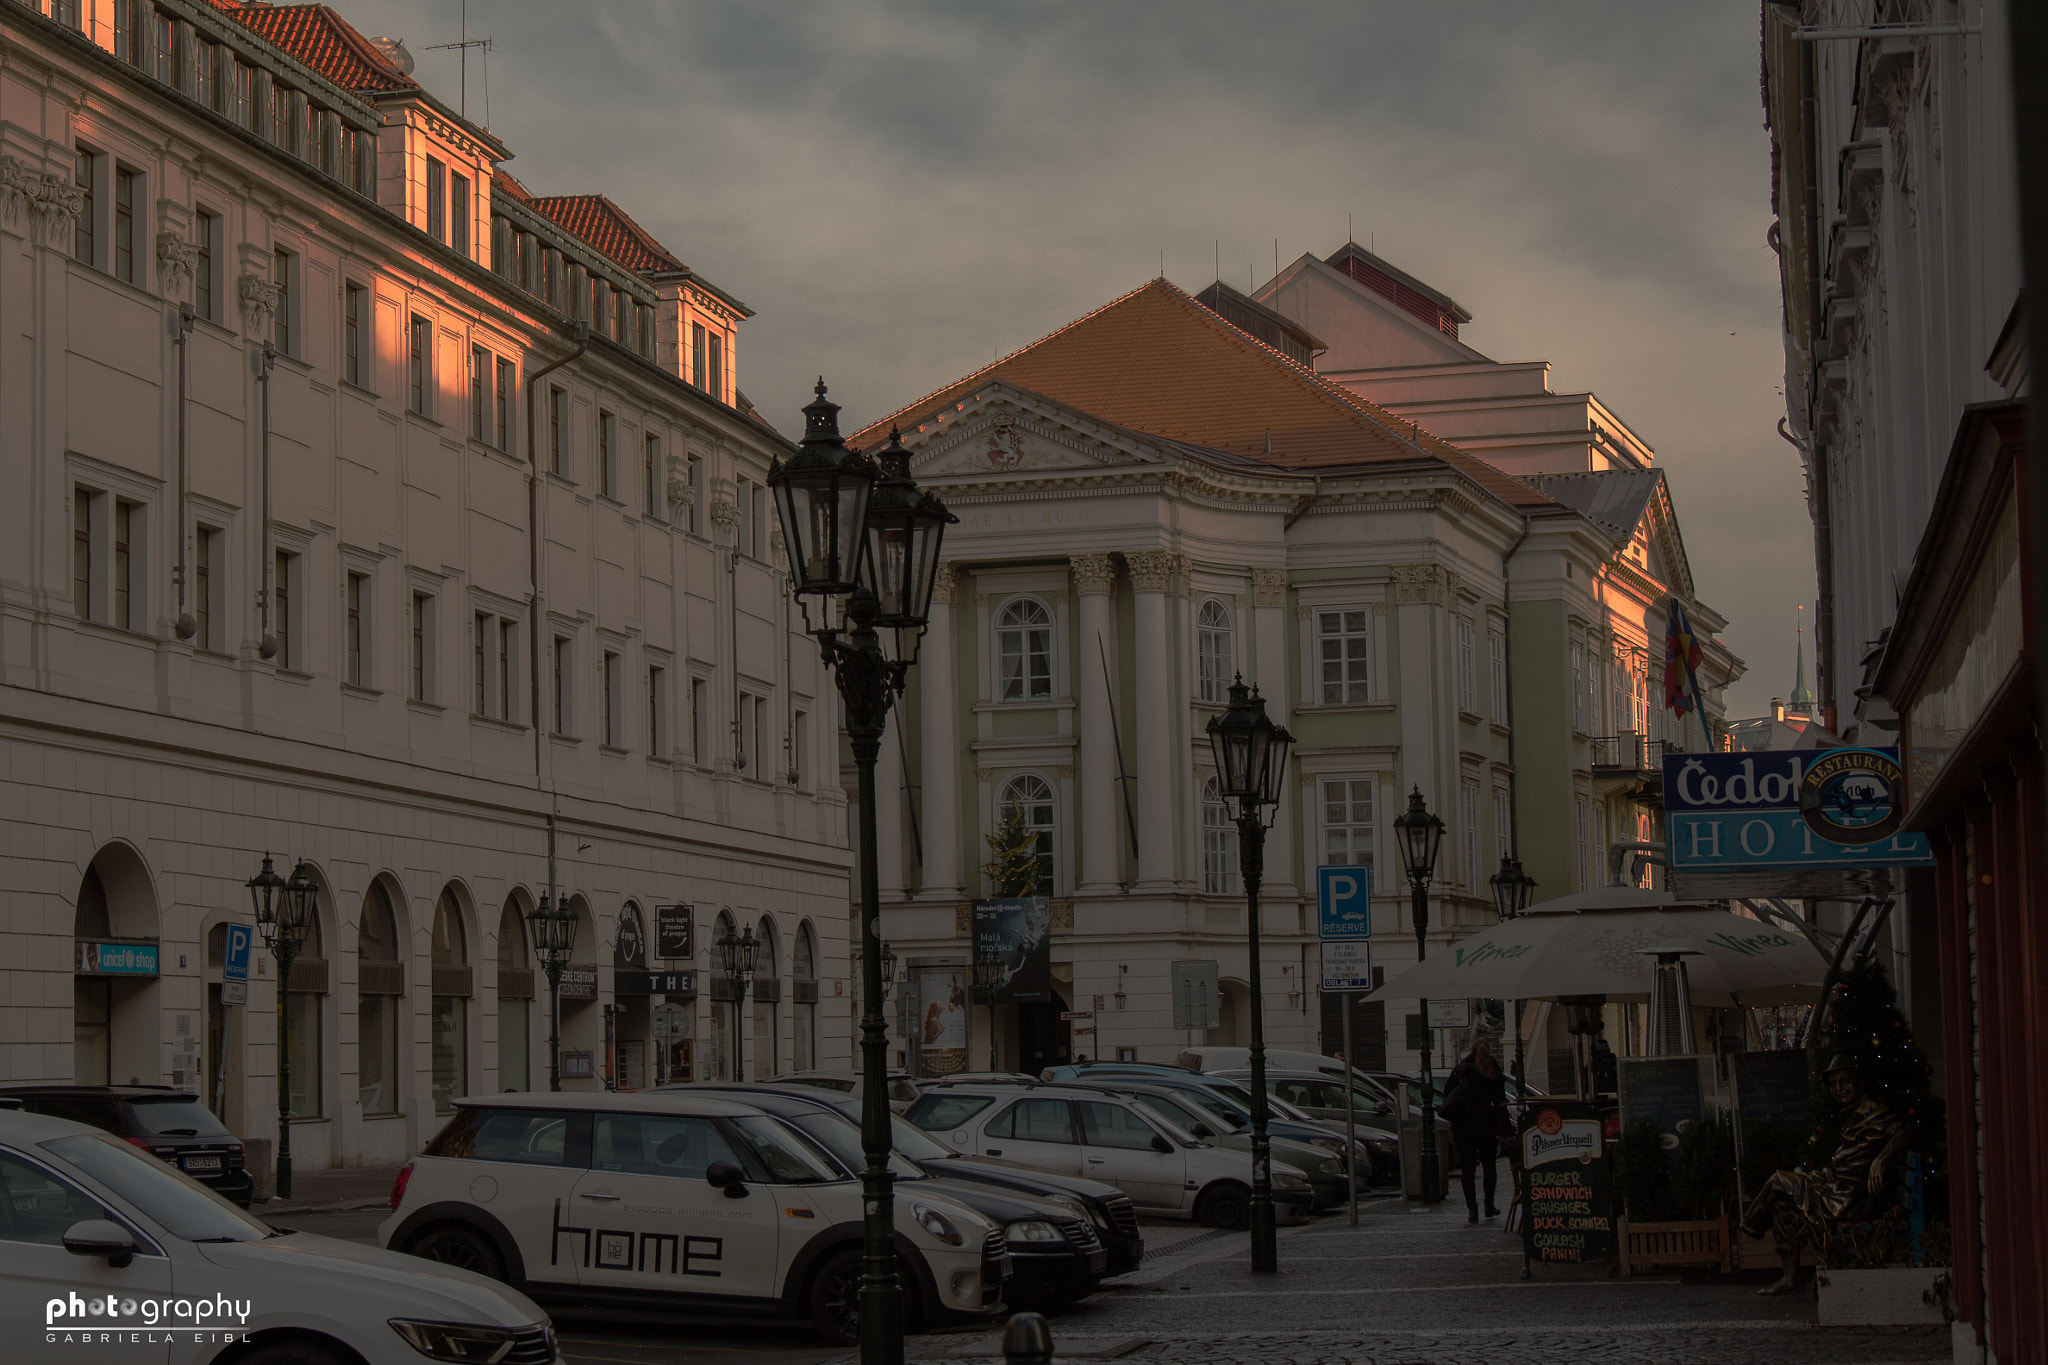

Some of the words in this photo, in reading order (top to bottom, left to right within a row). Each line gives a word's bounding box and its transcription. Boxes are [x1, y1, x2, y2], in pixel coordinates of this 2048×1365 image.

[1007, 512, 1025, 525] ET
[1806, 755, 1902, 787] RESTAURANT
[1329, 875, 1358, 915] P
[1324, 922, 1366, 933] RÉSERVÉ
[980, 932, 1001, 942] Malá
[1706, 932, 1797, 957] Vinea
[230, 930, 247, 962] P
[1454, 940, 1533, 968] Vinea
[103, 950, 126, 968] unicef
[135, 951, 155, 972] shop
[560, 968, 573, 982] ESKÉ
[1531, 1134, 1563, 1156] Pilsner
[1562, 1132, 1593, 1148] Urquell
[1531, 1171, 1582, 1187] BURGER
[1531, 1186, 1593, 1201] SANDWICH
[623, 1203, 753, 1220] svoboda-williams.com
[1531, 1201, 1591, 1216] SAUSAGES
[1534, 1216, 1566, 1230] DUCK
[551, 1198, 723, 1277] home
[1533, 1232, 1585, 1249] GOULASH
[1542, 1246, 1582, 1263] PANINI
